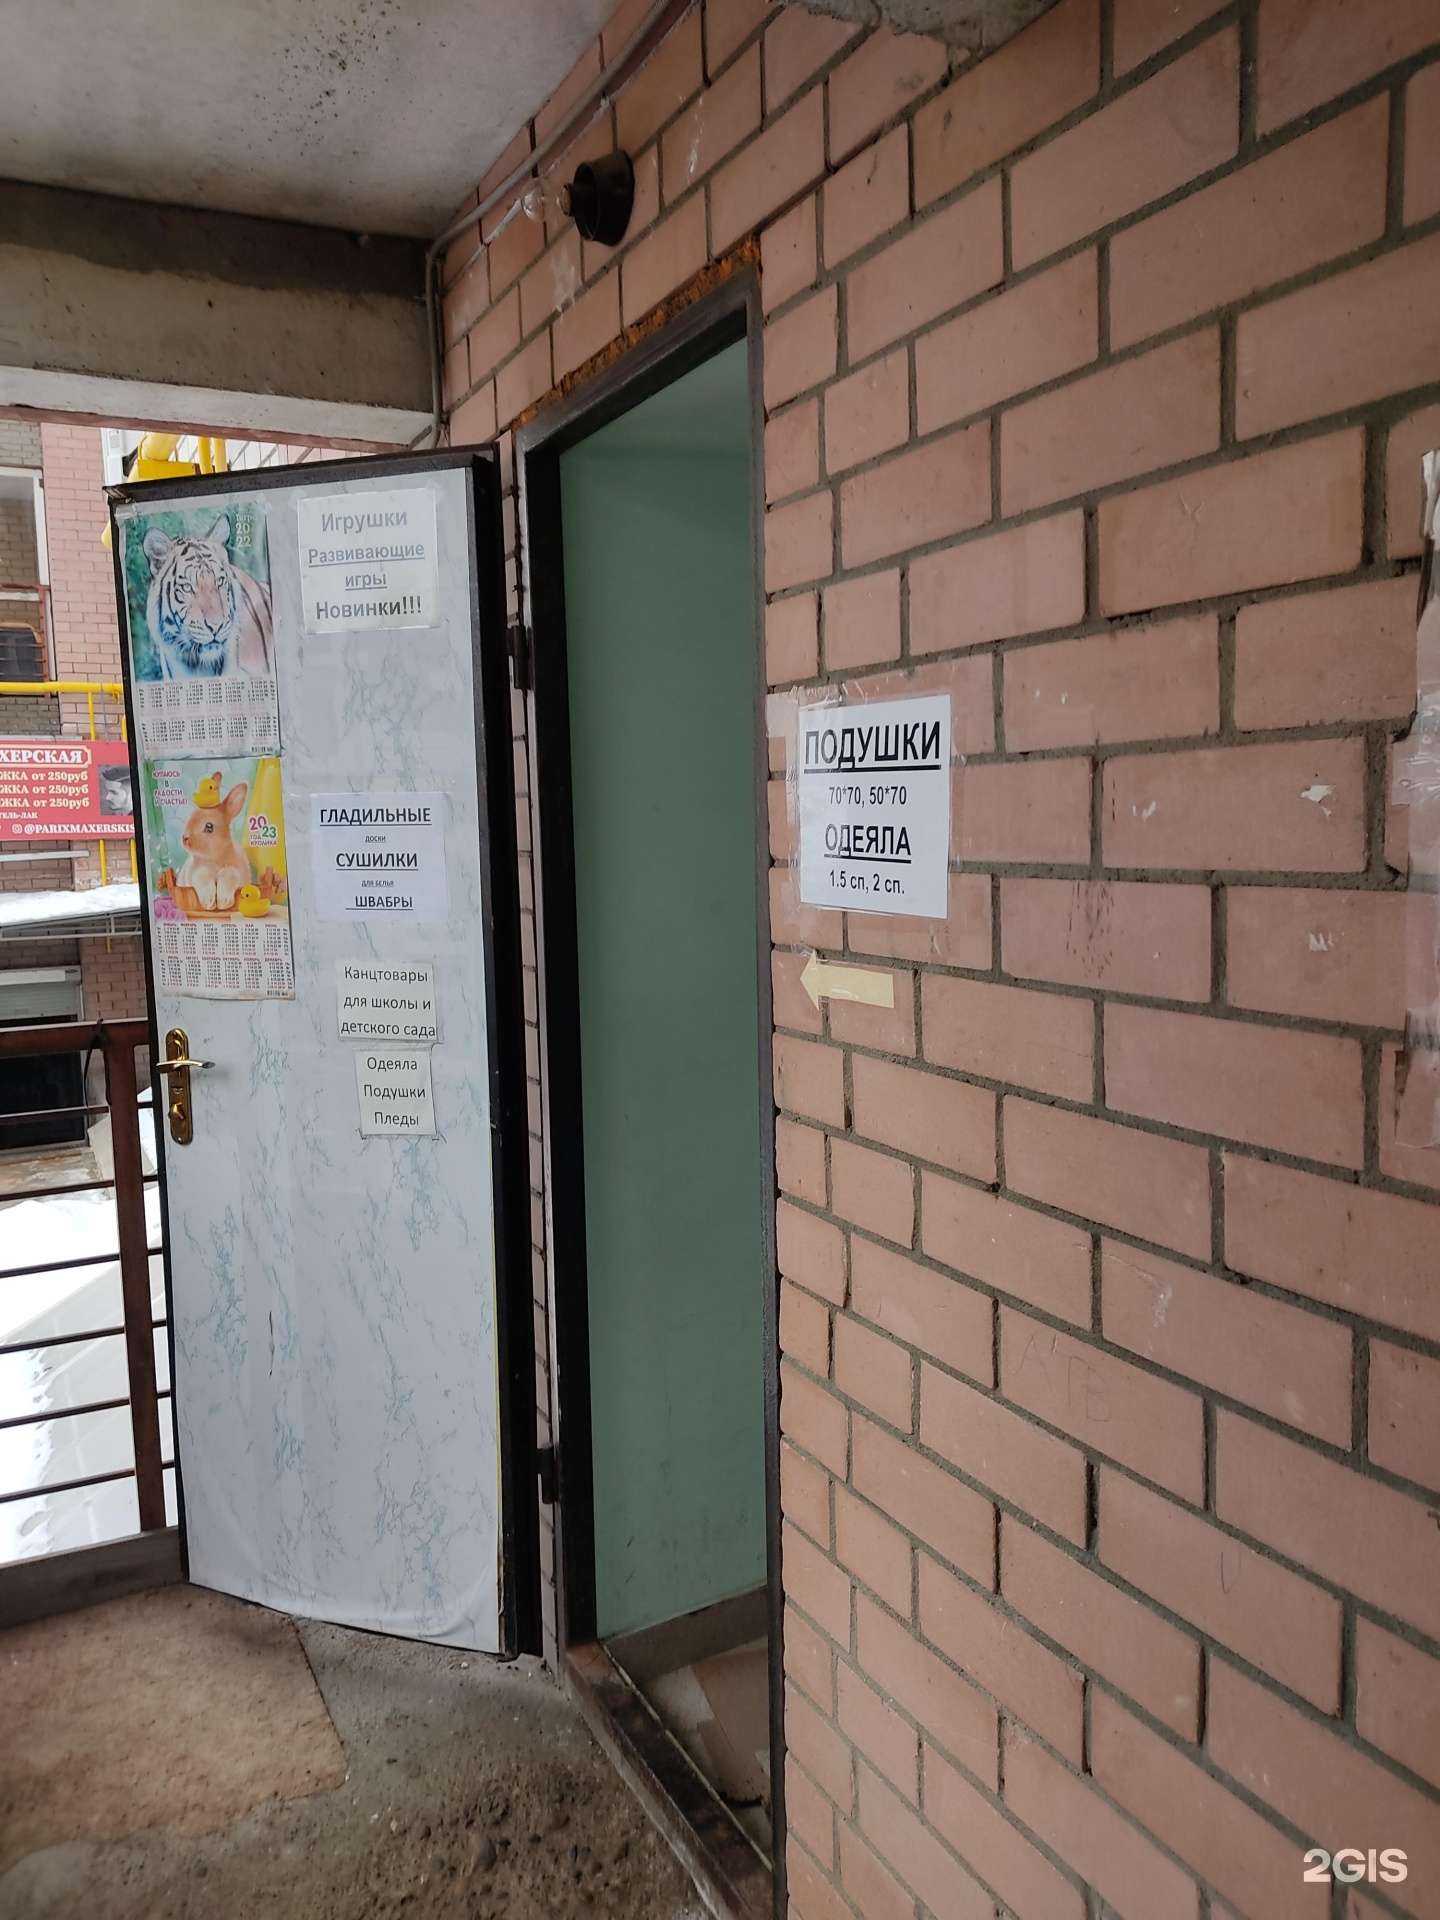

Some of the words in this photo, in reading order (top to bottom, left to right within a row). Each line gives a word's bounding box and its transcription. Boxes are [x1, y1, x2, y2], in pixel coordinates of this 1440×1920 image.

[321, 511, 408, 534] Игрушки
[308, 543, 425, 565] Развивающие
[345, 573, 387, 589] игры
[316, 595, 422, 620] Новинки!!!
[805, 721, 940, 769] ПОДУШКИ
[31, 773, 46, 781] от
[48, 771, 88, 783] 250руб
[48, 785, 89, 797] 250руб
[33, 800, 47, 808] от
[49, 798, 90, 812] 250руб
[320, 807, 432, 826] ГЛАДИЛЬНЫЕ
[364, 834, 386, 843] доски
[825, 823, 912, 857] ОДЕЯЛА
[336, 853, 418, 867] СУШИЛКИ
[829, 870, 847, 888] 1.5
[850, 874, 869, 894] сп,
[872, 873, 880, 891] 2
[884, 878, 906, 895] сп.
[355, 895, 413, 908] ШВАБРЫ
[344, 966, 429, 985] Канцтовары
[343, 996, 368, 1008] для
[371, 997, 418, 1010] школы
[423, 1000, 431, 1010] и
[341, 1021, 400, 1035] детского
[403, 1024, 436, 1038] сада
[366, 1057, 418, 1072] Одеяла
[363, 1084, 426, 1101] Подушки
[374, 1111, 419, 1128] Пледы
